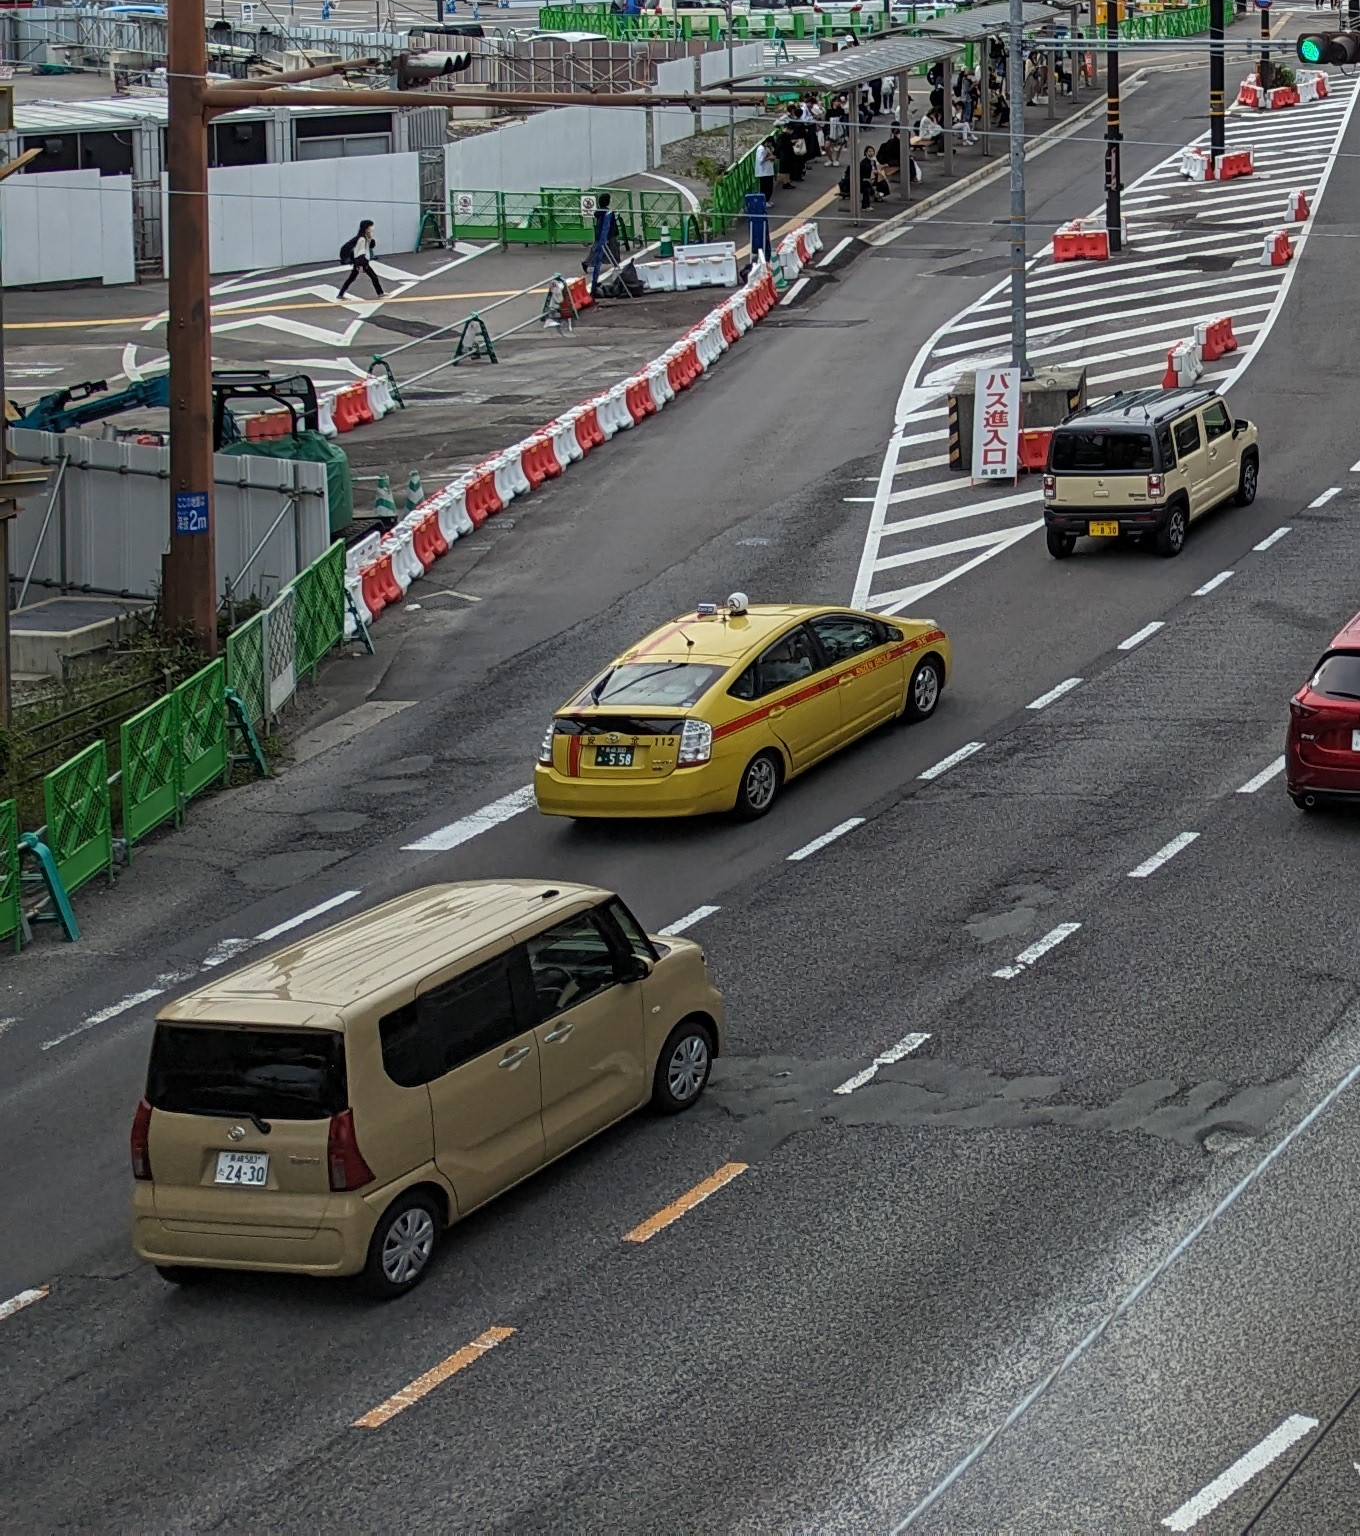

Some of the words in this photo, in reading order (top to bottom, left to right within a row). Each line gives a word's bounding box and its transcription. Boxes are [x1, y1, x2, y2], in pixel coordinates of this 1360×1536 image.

[982, 372, 1011, 466] バス進入口
[653, 736, 675, 747] 112
[225, 1164, 265, 1183] 24-30
